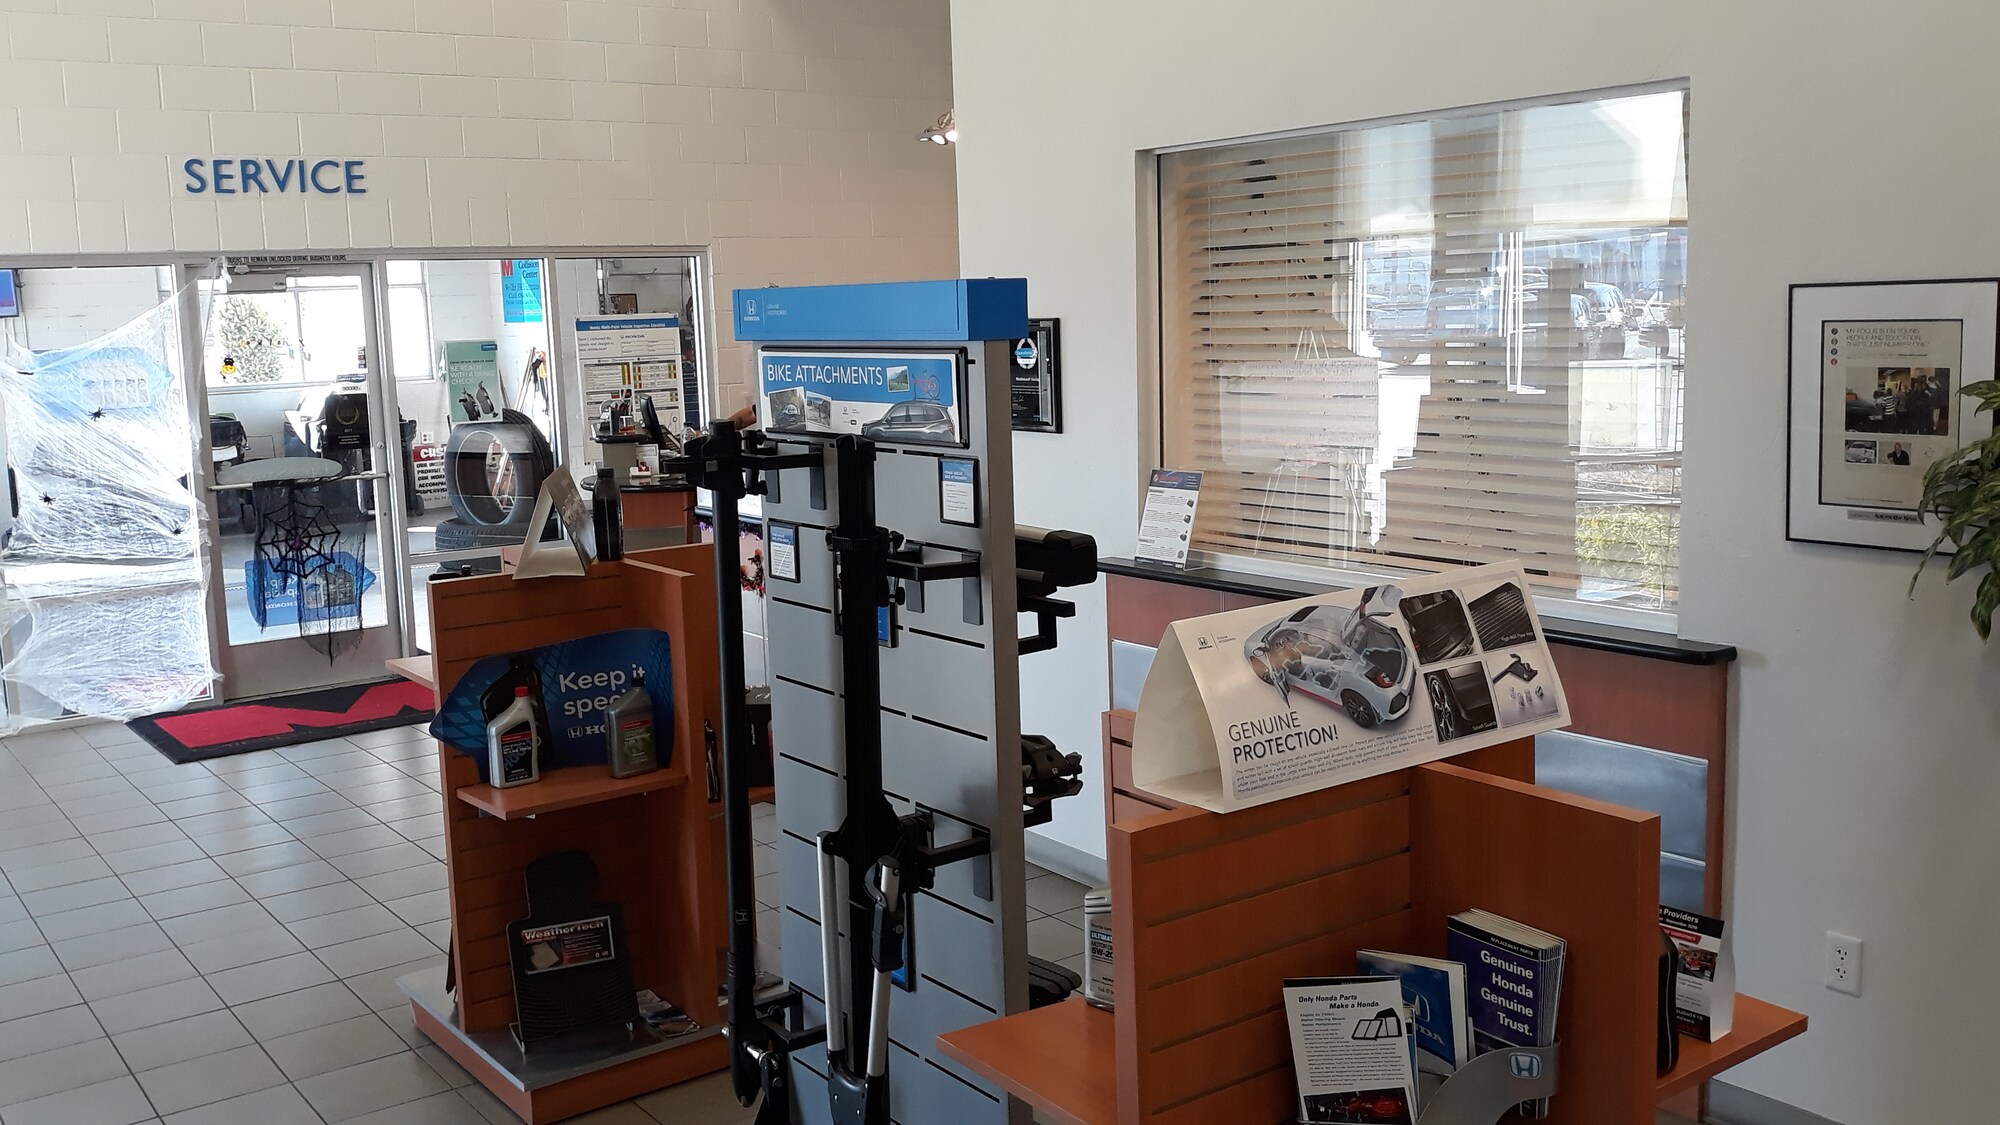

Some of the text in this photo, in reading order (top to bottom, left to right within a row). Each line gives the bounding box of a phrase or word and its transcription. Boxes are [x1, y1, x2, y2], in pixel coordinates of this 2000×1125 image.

[184, 159, 366, 193] SERVICE
[767, 364, 883, 386] BIKE ATTACHMENTS
[559, 664, 646, 693] Keep it
[1228, 711, 1301, 741] GENUINE
[1233, 724, 1339, 764] PROTECTION!
[1663, 908, 1699, 924] Providers
[524, 920, 604, 940] WeatherTech
[1092, 932, 1112, 942] ULTIMAT
[1490, 937, 1534, 956] REPLACEMENT PARTS
[1480, 950, 1534, 980] Genuine
[1492, 972, 1534, 999] Honda
[1298, 996, 1314, 1004] Only
[1329, 1002, 1350, 1010] Make
[1480, 987, 1534, 1018] Genuine
[1497, 1011, 1533, 1037] Trust.
